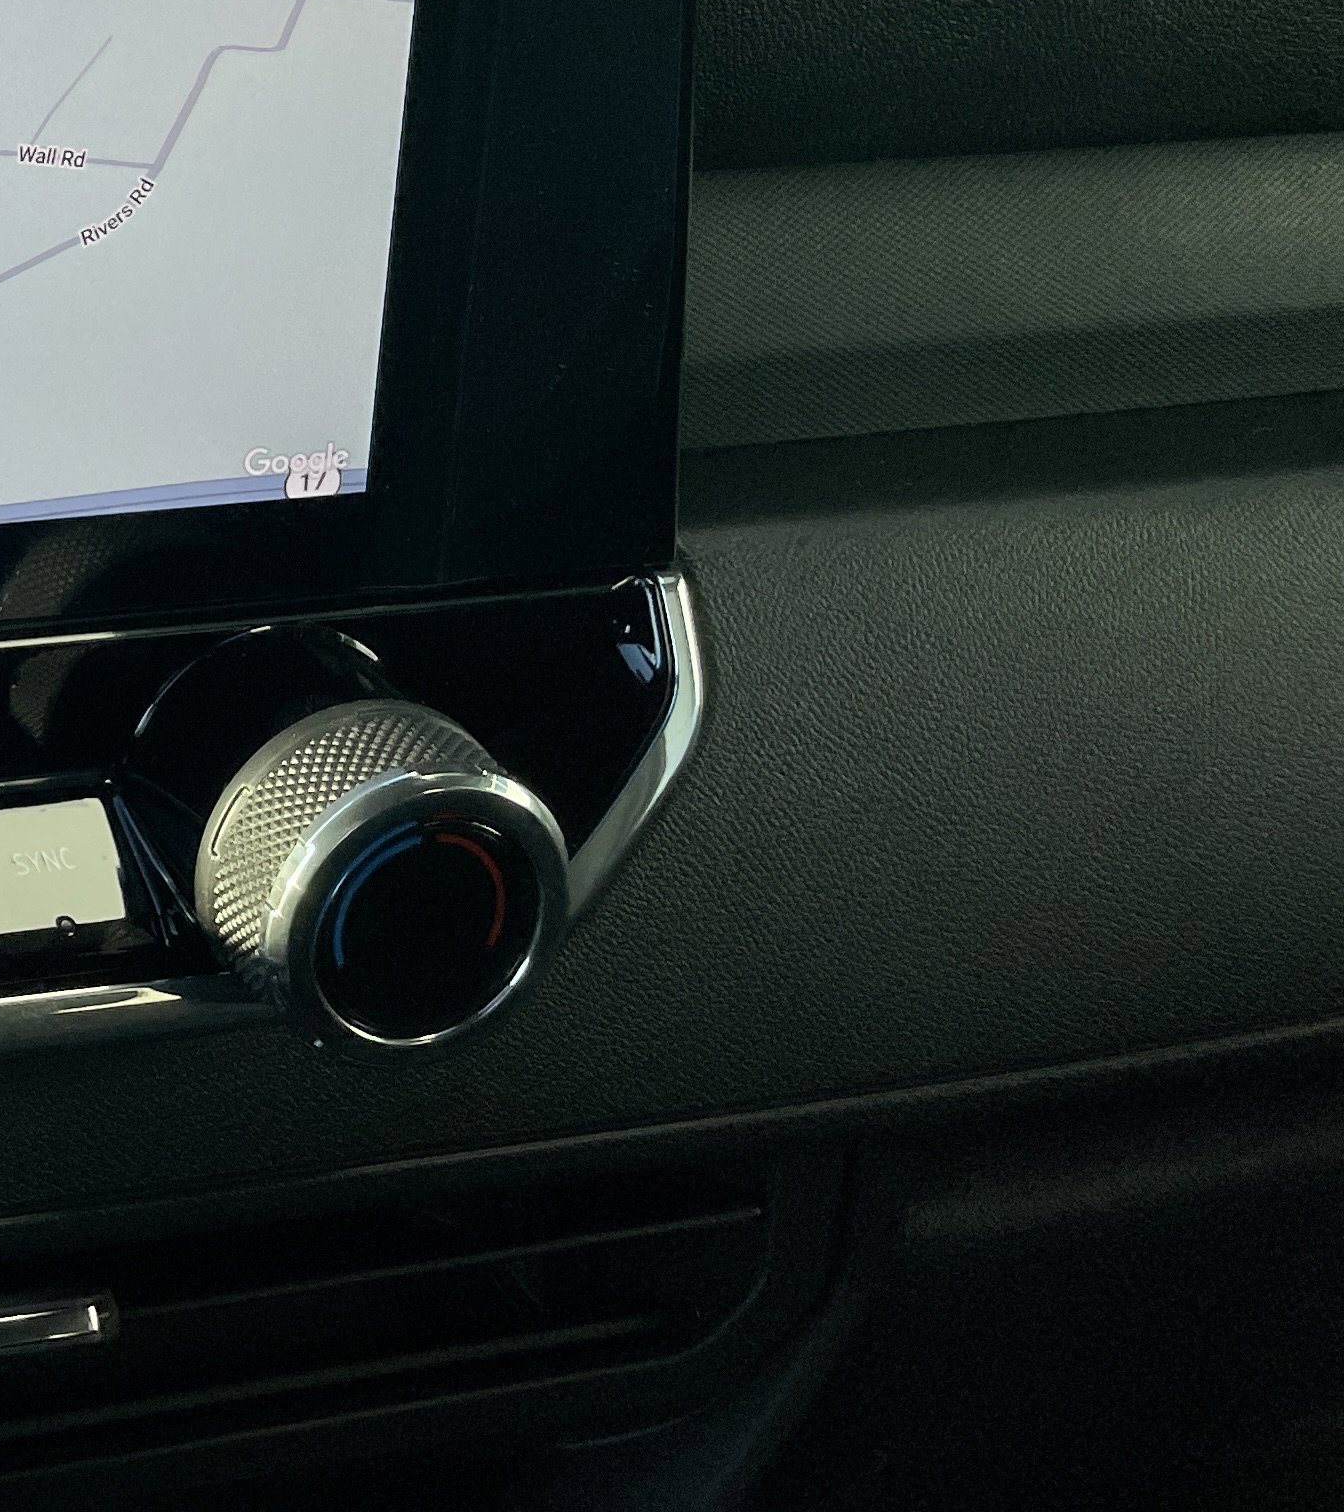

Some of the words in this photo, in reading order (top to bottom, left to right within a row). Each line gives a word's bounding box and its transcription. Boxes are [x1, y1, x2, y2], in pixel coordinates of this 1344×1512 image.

[18, 145, 56, 165] Wall
[59, 151, 85, 169] Rd
[80, 203, 133, 246] Rivers
[130, 177, 155, 207] Rd
[244, 442, 349, 479] Google
[12, 847, 76, 877] SYNC
